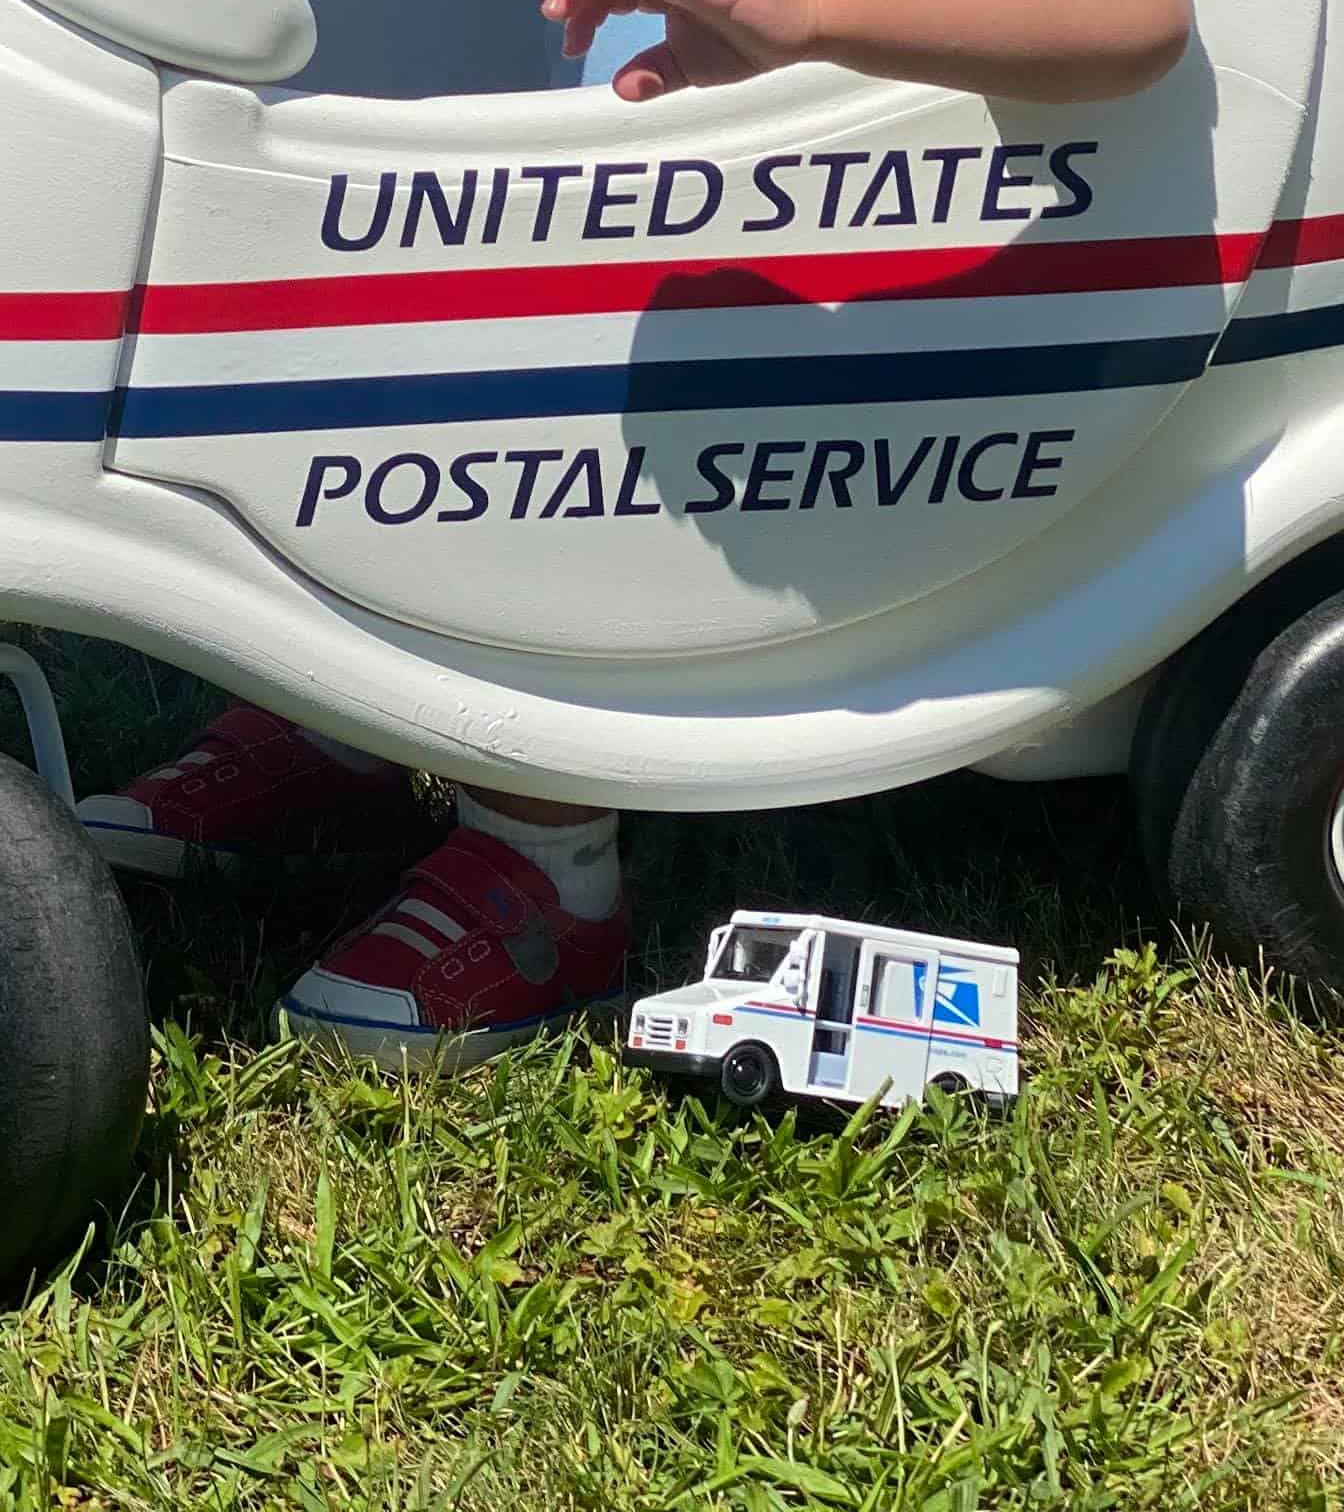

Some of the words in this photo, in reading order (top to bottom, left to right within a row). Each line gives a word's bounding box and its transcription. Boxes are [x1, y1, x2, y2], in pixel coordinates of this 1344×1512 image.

[320, 160, 726, 252] UNITED
[742, 140, 1100, 232] STATES
[294, 445, 662, 527] POSTAL
[682, 428, 1077, 514] SERVICE
